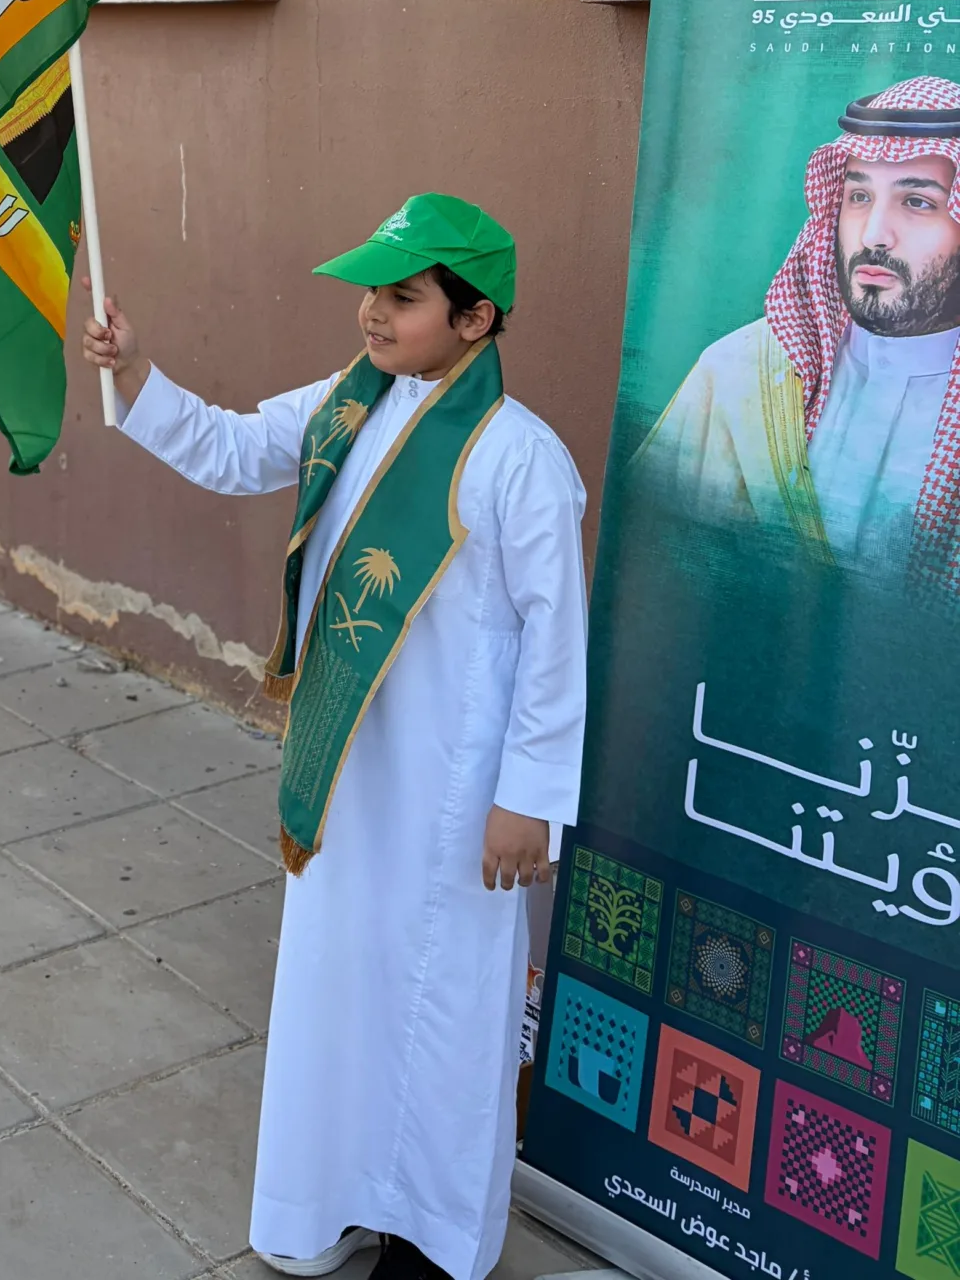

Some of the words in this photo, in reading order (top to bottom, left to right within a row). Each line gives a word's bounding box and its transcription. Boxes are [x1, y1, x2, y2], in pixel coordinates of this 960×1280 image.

[751, 9, 776, 24] 95
[780, 4, 911, 34] السعودي
[750, 42, 824, 53] SAUDI
[604, 1173, 677, 1221] السعدي
[670, 1166, 721, 1203] المدرسة
[721, 1197, 751, 1220] مدير
[681, 1214, 731, 1251] عوض
[734, 1242, 782, 1280] ماجد
